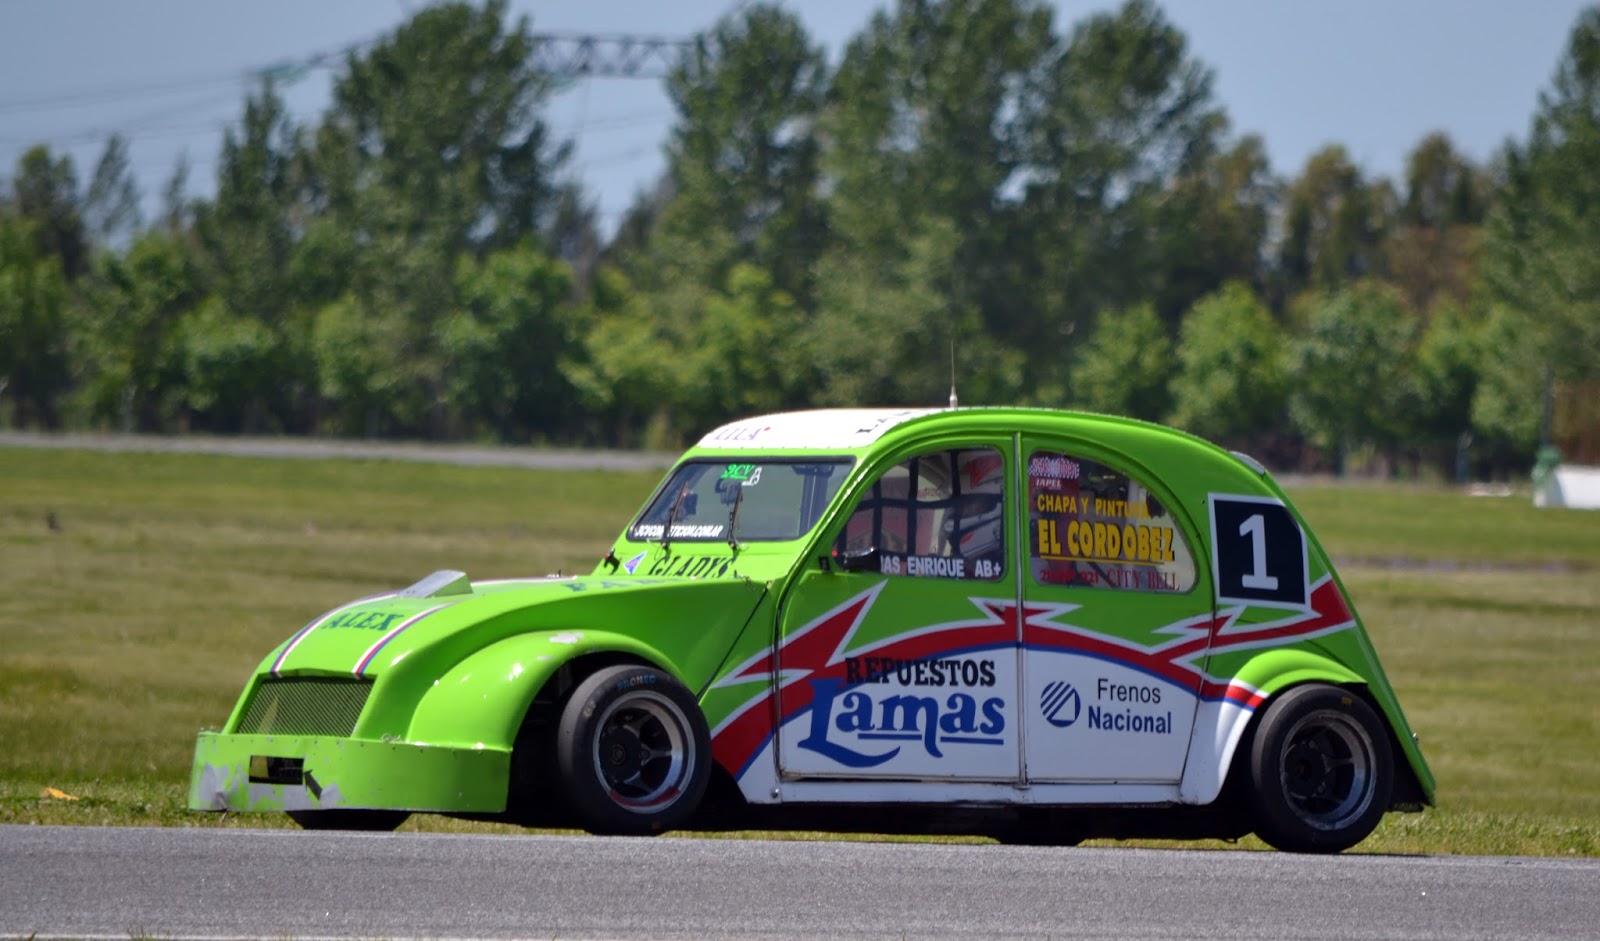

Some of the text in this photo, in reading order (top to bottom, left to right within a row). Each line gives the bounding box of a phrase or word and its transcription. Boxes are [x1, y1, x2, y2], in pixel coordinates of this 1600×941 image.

[1037, 494, 1150, 519] CHAPA Y PINTURA
[1038, 519, 1175, 562] EL CORDOBEZ
[1239, 514, 1279, 590] 1
[907, 556, 965, 577] ENRIQUE
[975, 560, 1001, 578] AB+
[1108, 569, 1144, 589] CITY
[1148, 571, 1180, 591] BELL
[322, 611, 405, 631] ALEX
[845, 657, 996, 687] REPUESTOS
[1097, 678, 1162, 705] Frenos
[797, 678, 1005, 768] Lamas
[1088, 706, 1172, 735] Nacional
